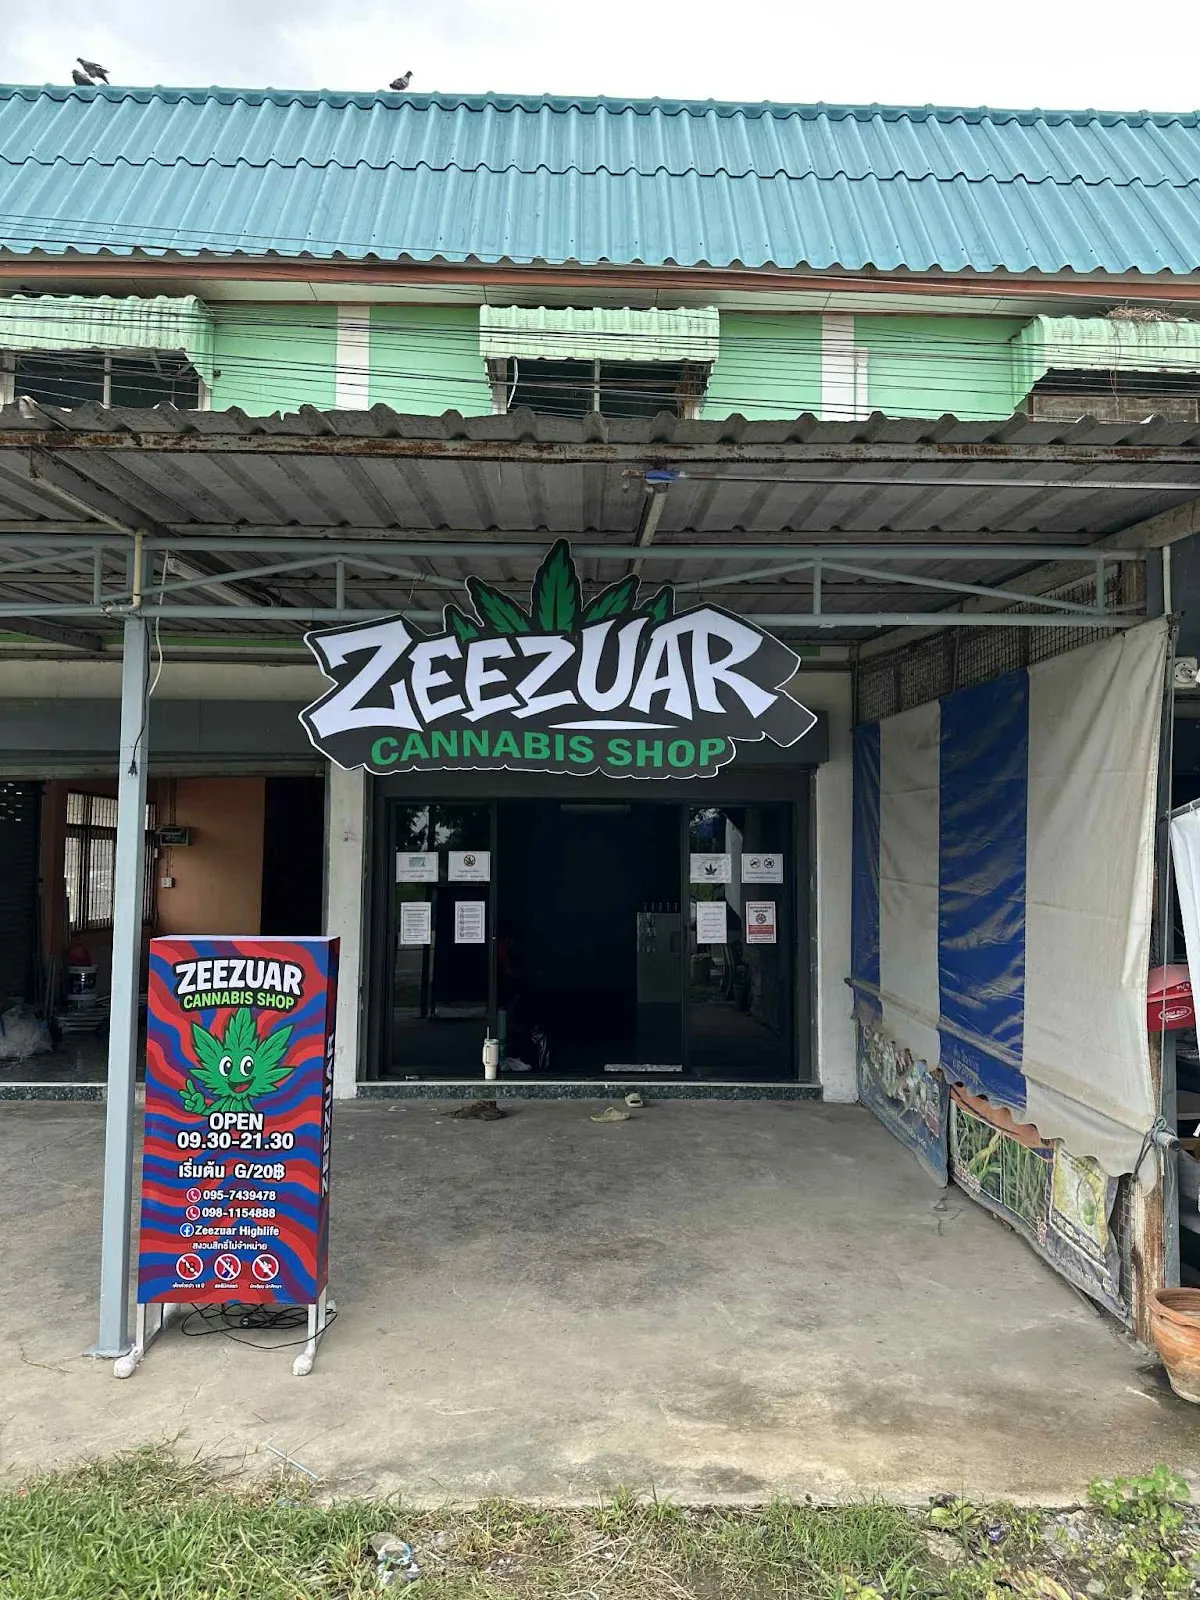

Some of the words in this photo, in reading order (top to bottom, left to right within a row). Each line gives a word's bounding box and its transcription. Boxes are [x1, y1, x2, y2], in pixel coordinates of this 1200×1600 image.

[310, 608, 778, 738] ZEEZUAR
[371, 730, 595, 764] CANNABIS
[606, 737, 727, 768] SHOP
[175, 959, 303, 996] ZEEZUAR
[183, 991, 254, 1009] CANNABIS
[256, 993, 295, 1010] SHOP
[209, 1112, 264, 1131] OPEN
[176, 1131, 294, 1150] 09.30-21.30
[178, 1158, 226, 1179] เริ่มต้น
[234, 1162, 286, 1181] G/20฿
[202, 1190, 277, 1201] 095-7439478
[201, 1207, 277, 1218] 098-1154888
[194, 1225, 237, 1236] Zeezuar
[239, 1225, 280, 1238] Highlife
[191, 1239, 269, 1250] สงวนสิทธิ์ไม่จำหน่าย
